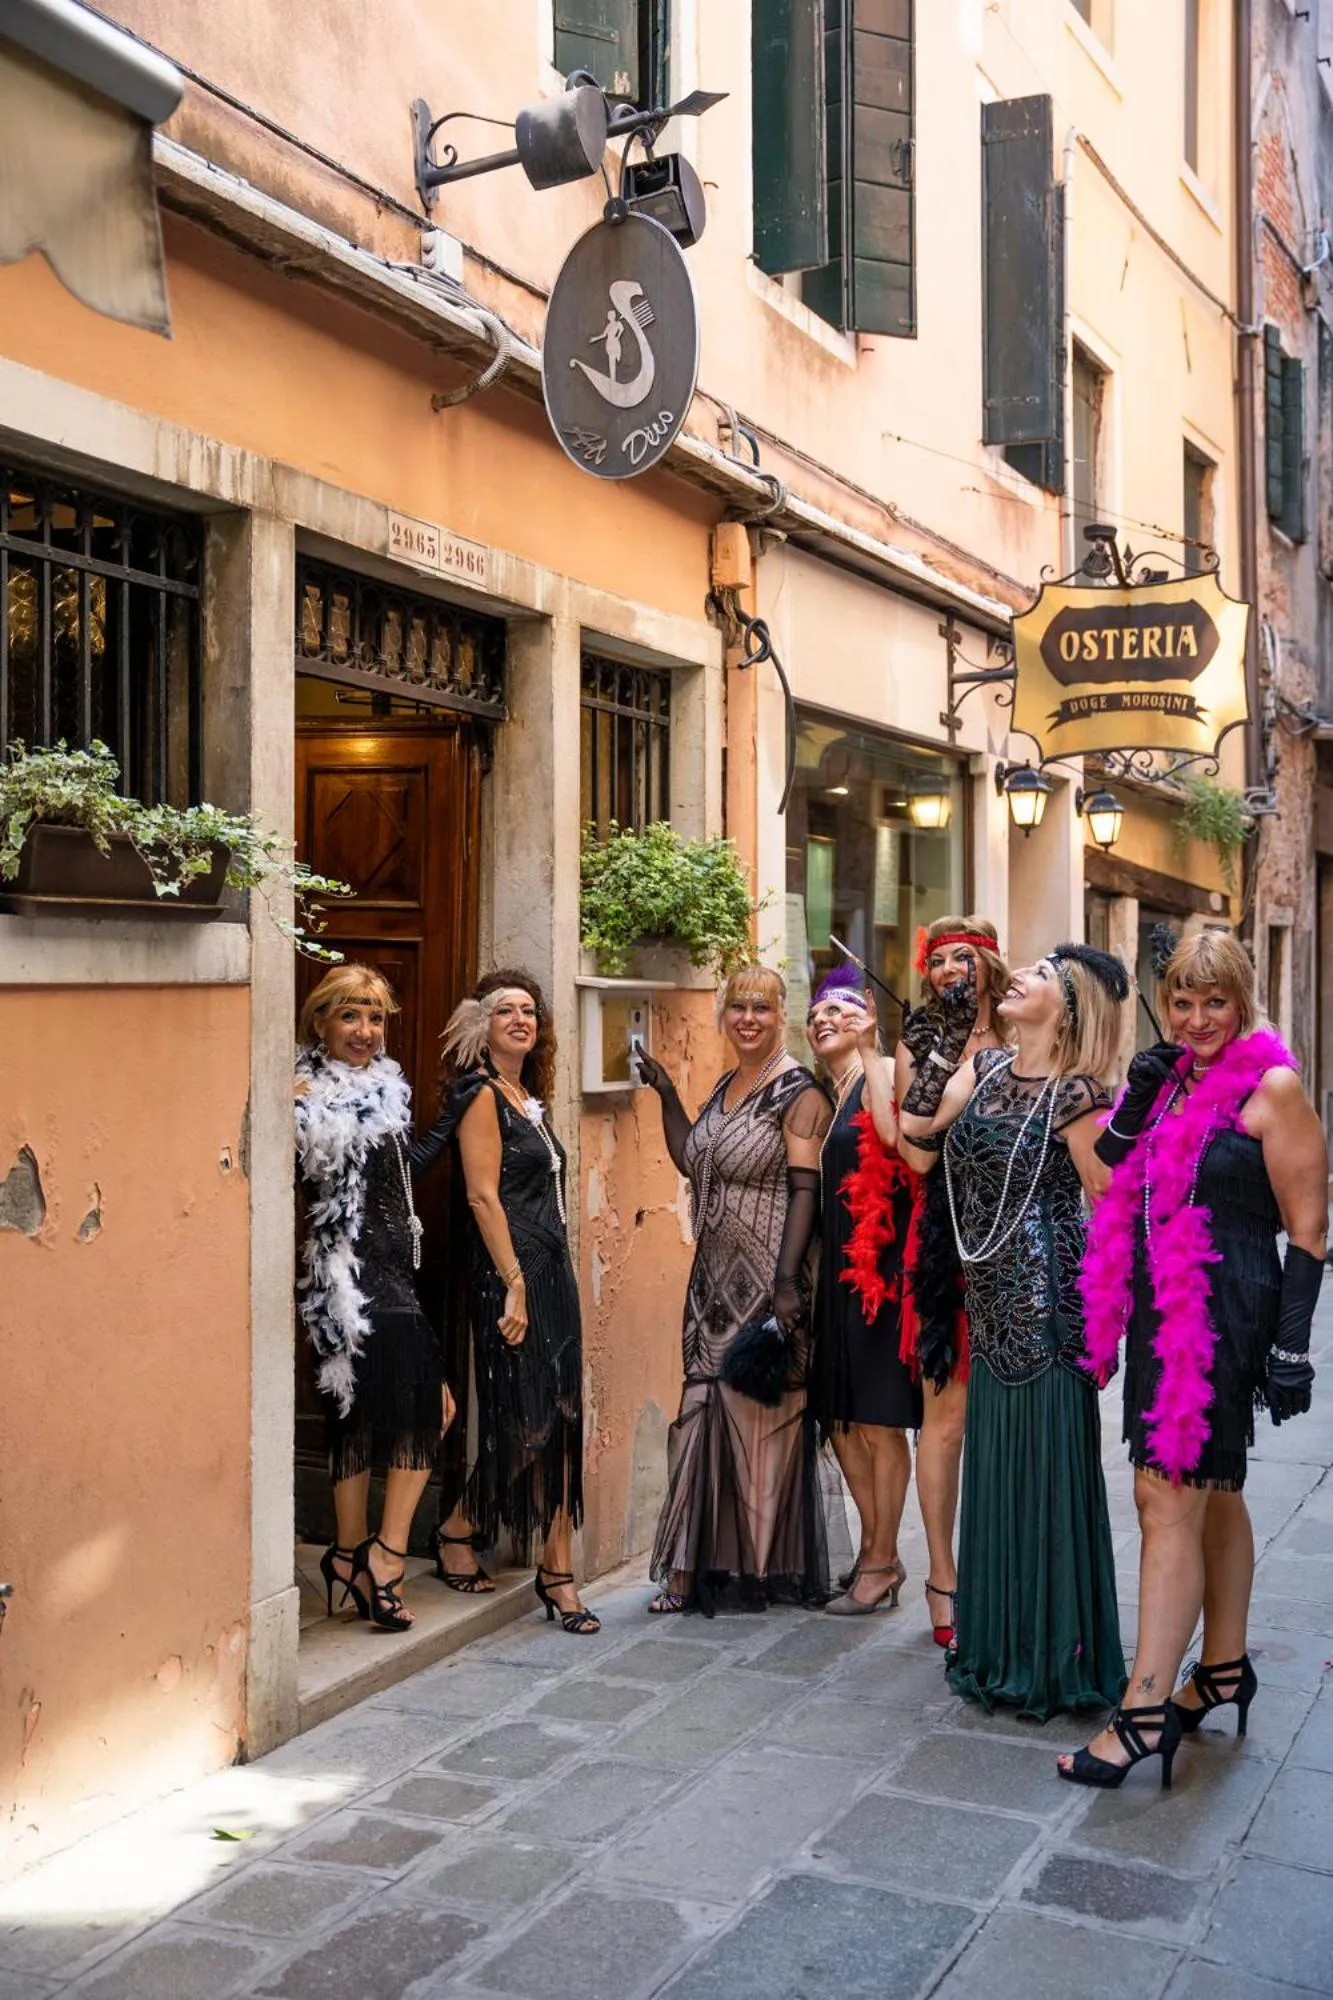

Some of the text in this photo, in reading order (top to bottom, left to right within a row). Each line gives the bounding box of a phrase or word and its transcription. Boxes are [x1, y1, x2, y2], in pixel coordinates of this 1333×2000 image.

[392, 521, 436, 559] 2965
[444, 543, 484, 576] 2966
[1060, 625, 1198, 662] OSTERIA
[1070, 694, 1188, 714] DOGE MOROSINI
